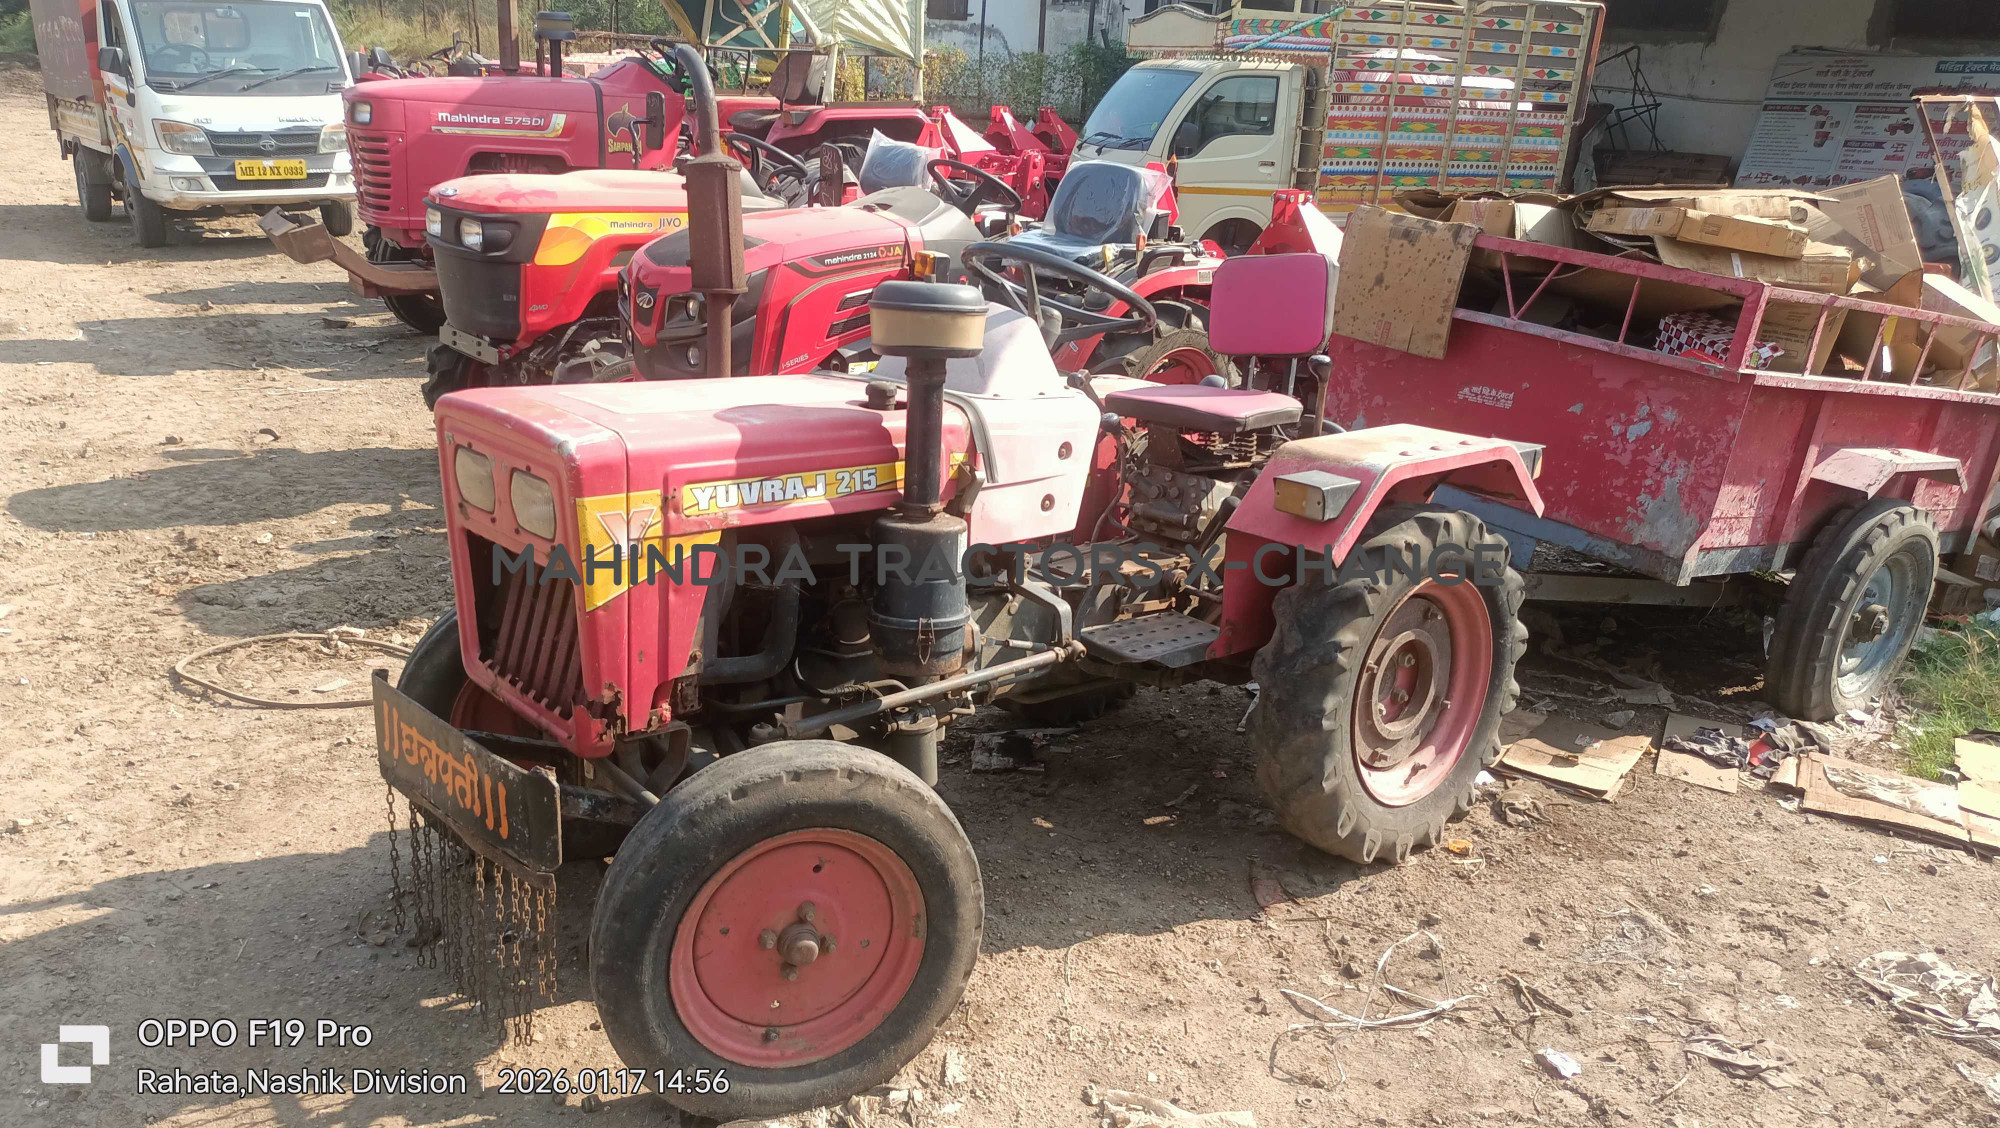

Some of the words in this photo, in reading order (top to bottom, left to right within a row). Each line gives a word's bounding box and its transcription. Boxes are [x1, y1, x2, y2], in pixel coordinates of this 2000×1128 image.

[438, 112, 500, 124] Mahindra
[239, 167, 255, 177] MH
[257, 166, 267, 176] 12
[269, 166, 282, 176] NX
[284, 164, 304, 176] 0333
[610, 221, 653, 229] Mahindra
[658, 217, 682, 230] JIVO
[824, 253, 862, 265] mahindra
[878, 246, 902, 258] OJA
[691, 473, 827, 511] YUVRAJ
[836, 468, 877, 494] 215
